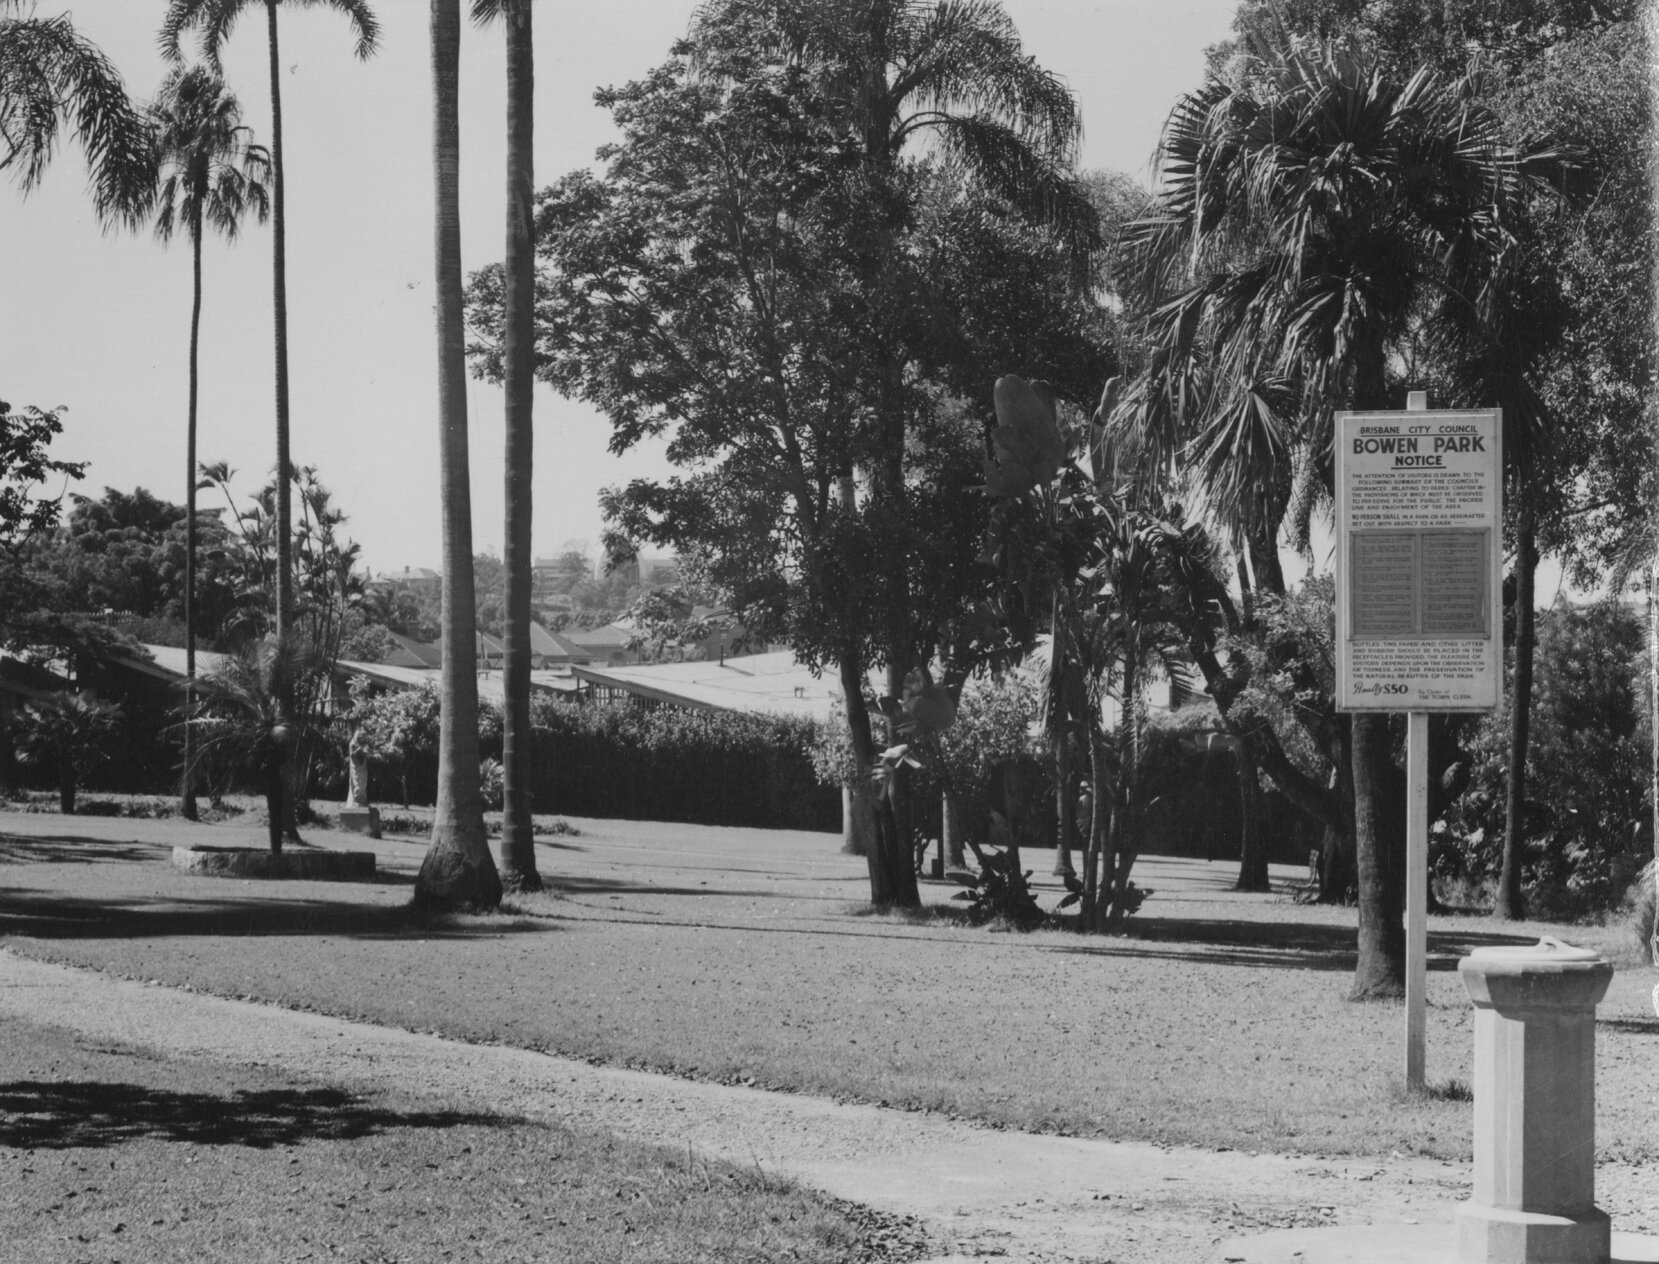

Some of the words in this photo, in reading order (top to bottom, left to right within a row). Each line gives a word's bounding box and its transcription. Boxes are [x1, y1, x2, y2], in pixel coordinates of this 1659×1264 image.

[1438, 425, 1478, 433] COUNCIL
[1353, 438, 1418, 454] BOWEN
[1434, 436, 1486, 453] PARK
[1395, 456, 1442, 466] NOTICE
